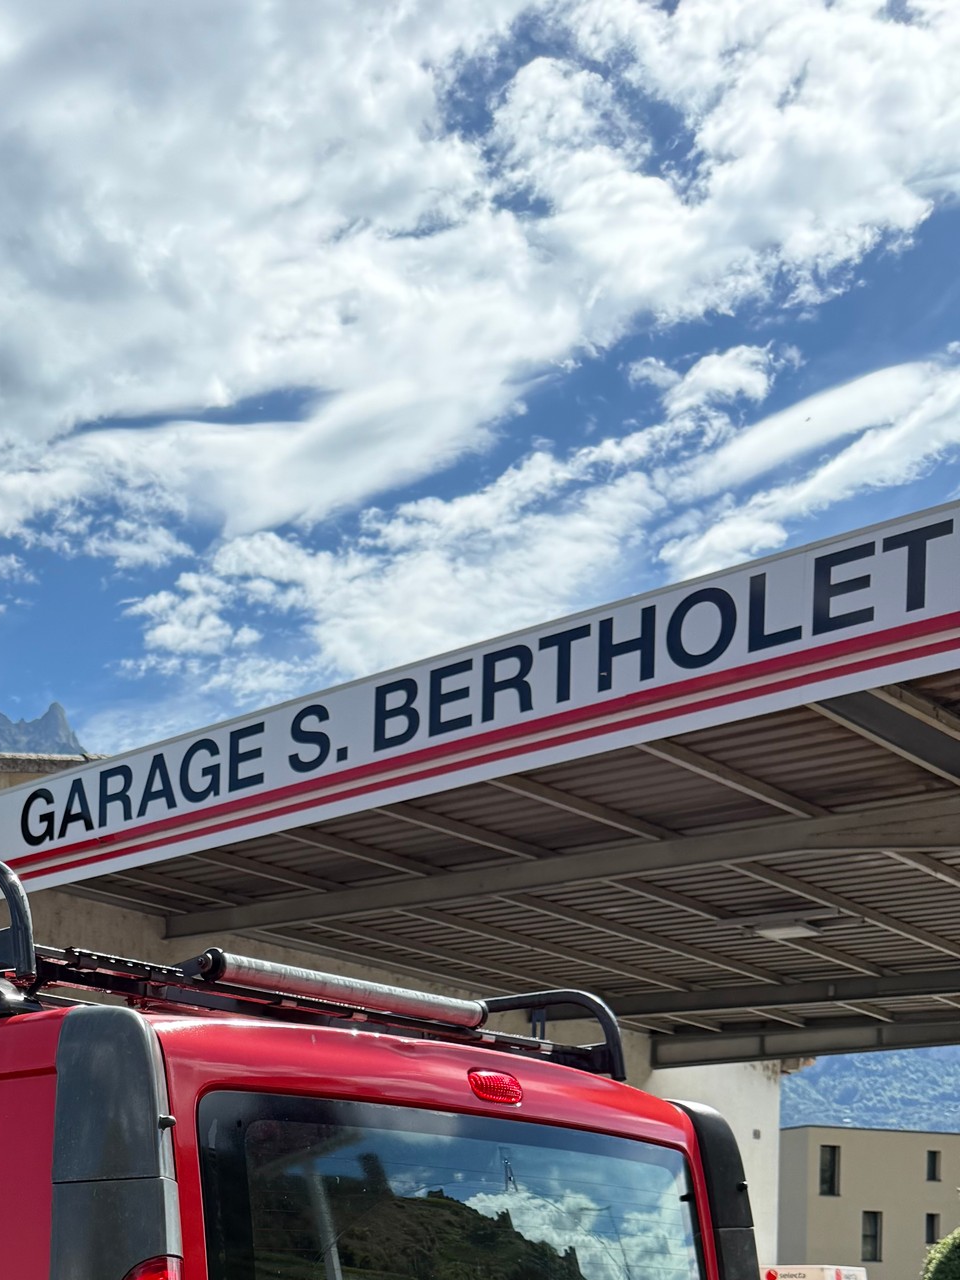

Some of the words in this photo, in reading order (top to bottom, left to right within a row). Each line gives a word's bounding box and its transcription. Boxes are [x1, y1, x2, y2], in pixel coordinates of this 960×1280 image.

[19, 720, 266, 847] GARAGE
[287, 703, 349, 774] S.
[372, 517, 956, 753] BERTHOLET
